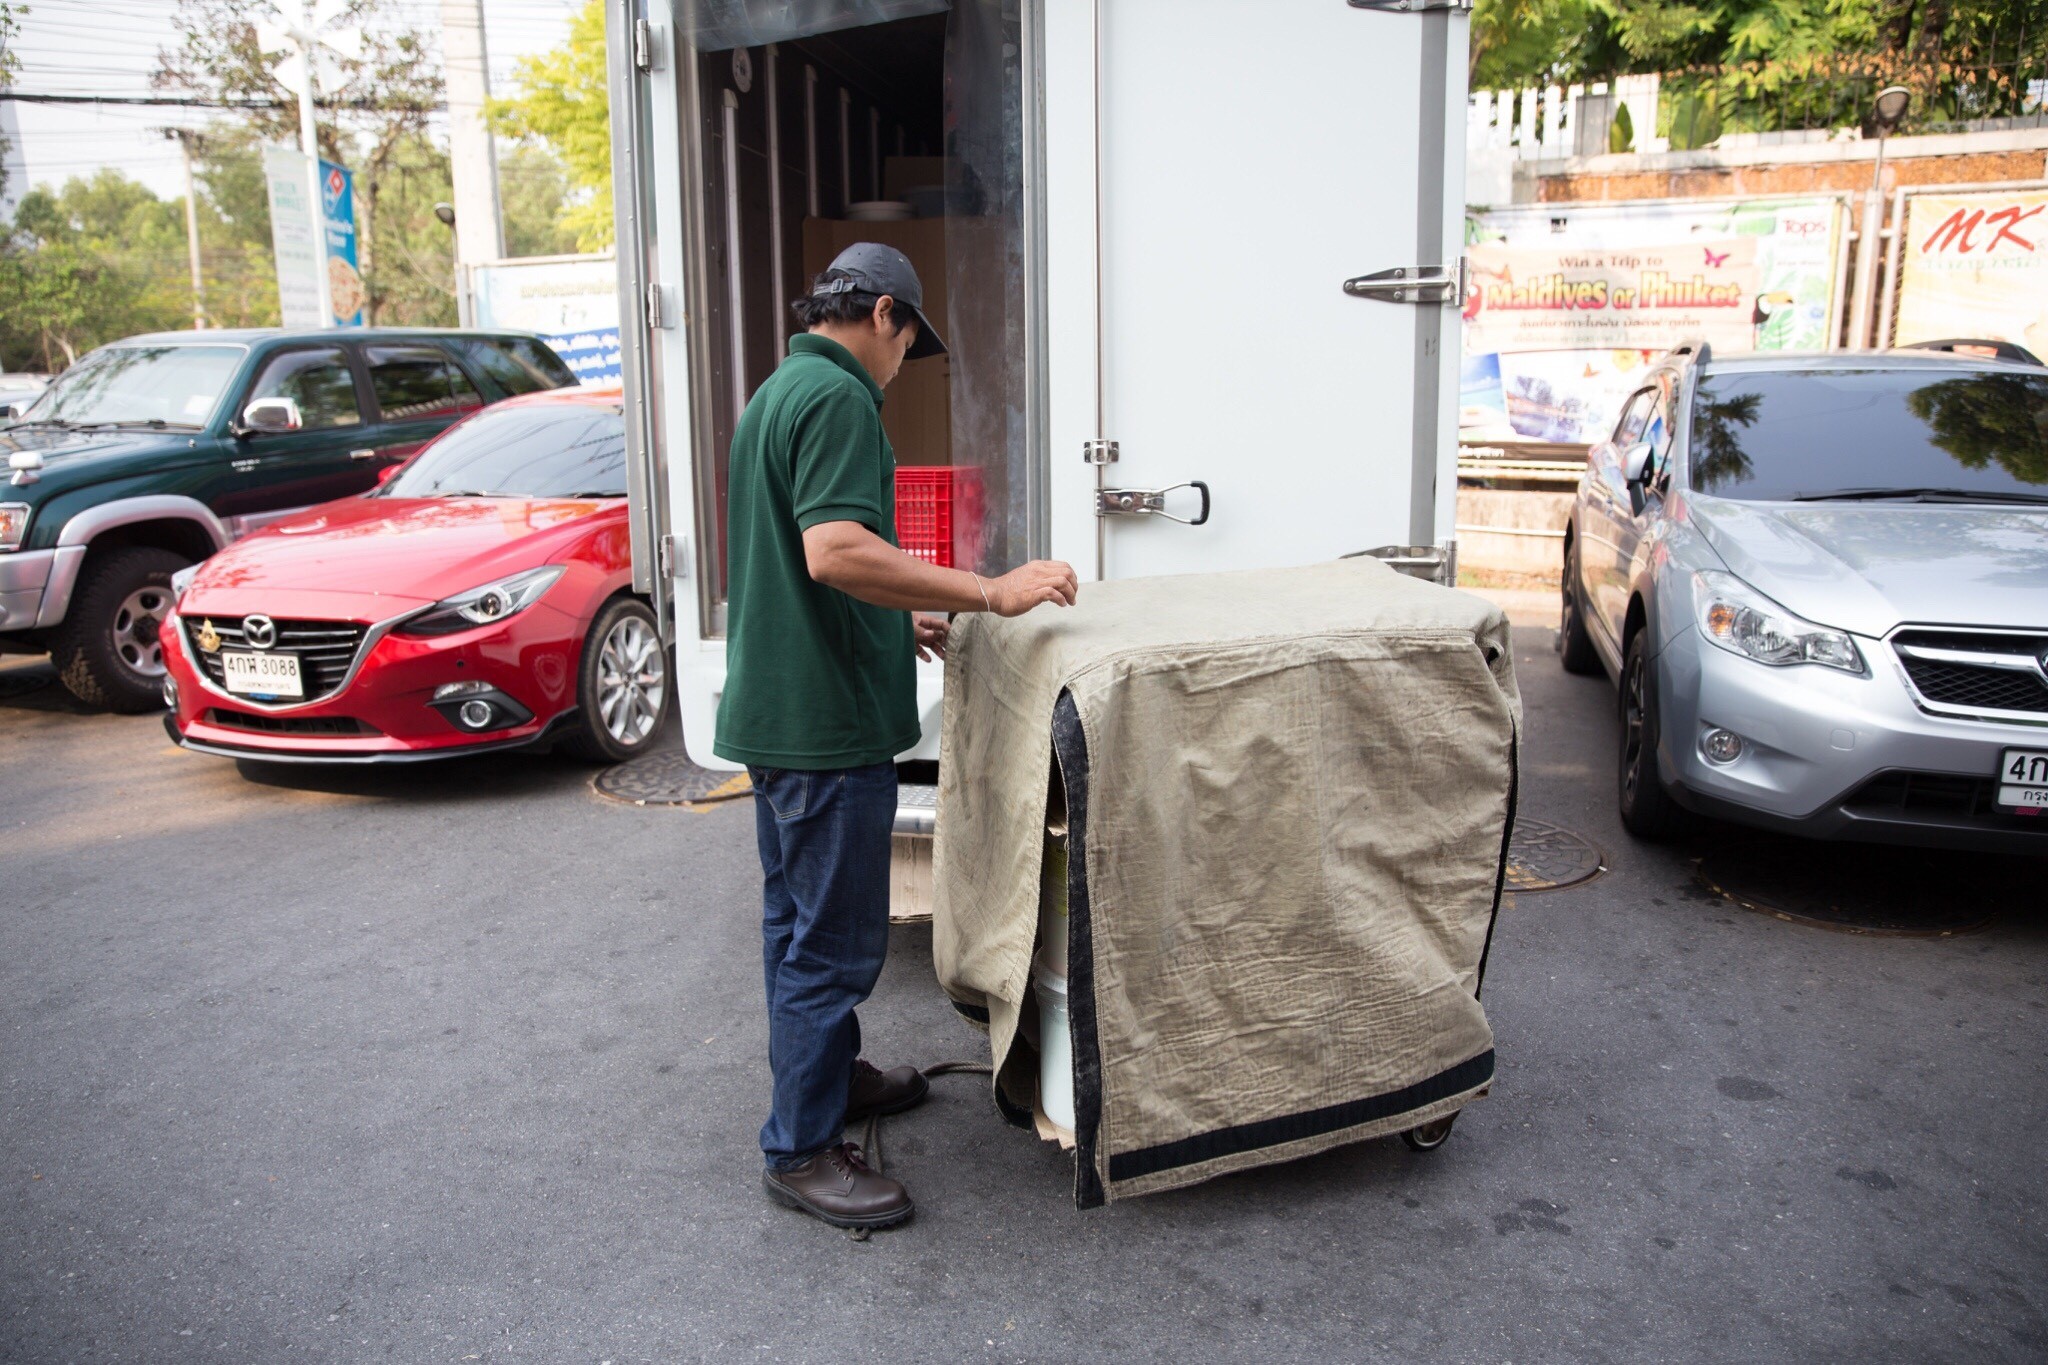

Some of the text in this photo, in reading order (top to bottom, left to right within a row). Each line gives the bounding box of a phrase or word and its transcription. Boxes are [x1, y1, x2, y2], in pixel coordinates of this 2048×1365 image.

[1783, 218, 1826, 238] Tops
[1922, 204, 2047, 254] MK
[1558, 255, 1663, 269] Win a Trip to
[1486, 271, 1742, 311] Maldives or Phuket
[262, 659, 297, 676] 3088
